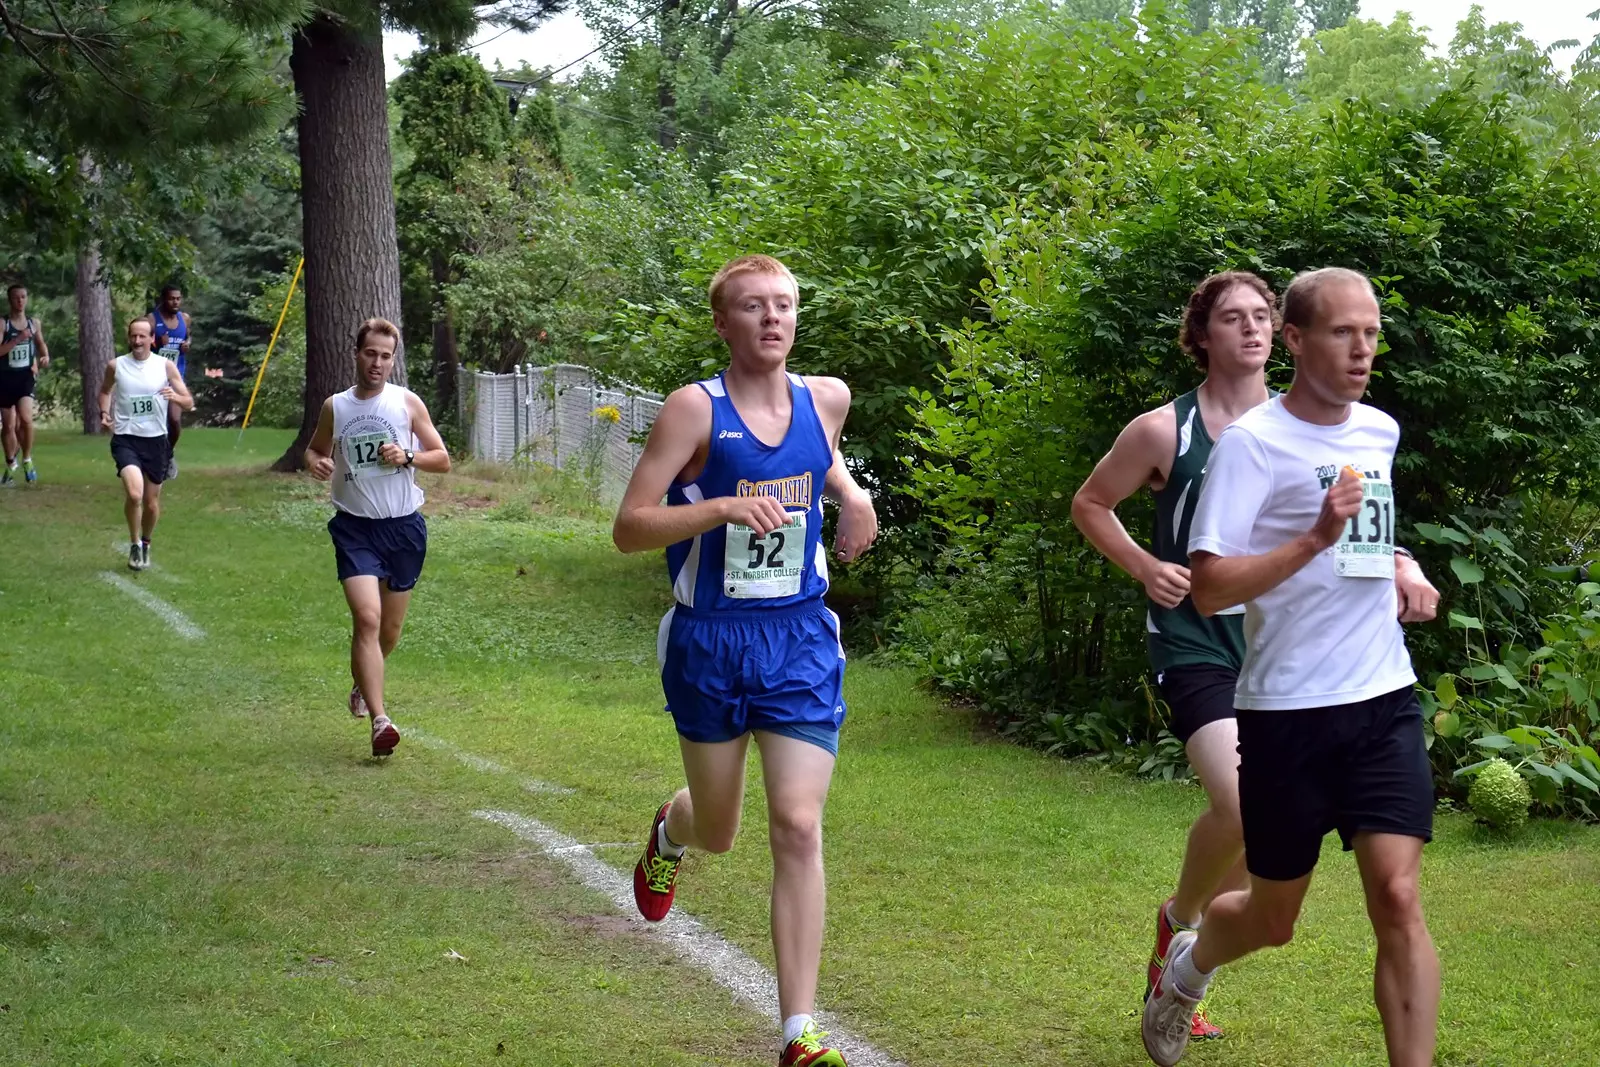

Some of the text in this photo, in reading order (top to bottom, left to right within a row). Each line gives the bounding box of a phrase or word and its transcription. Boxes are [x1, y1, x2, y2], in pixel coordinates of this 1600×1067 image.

[12, 350, 27, 360] 113
[133, 400, 153, 413] 138
[341, 414, 366, 435] HODGES
[1315, 464, 1337, 478] 2012
[1348, 499, 1391, 545] 131
[747, 531, 785, 569] 52
[1353, 544, 1380, 554] NORBERT
[730, 567, 799, 579] ST. NORBERT COLLEGE
